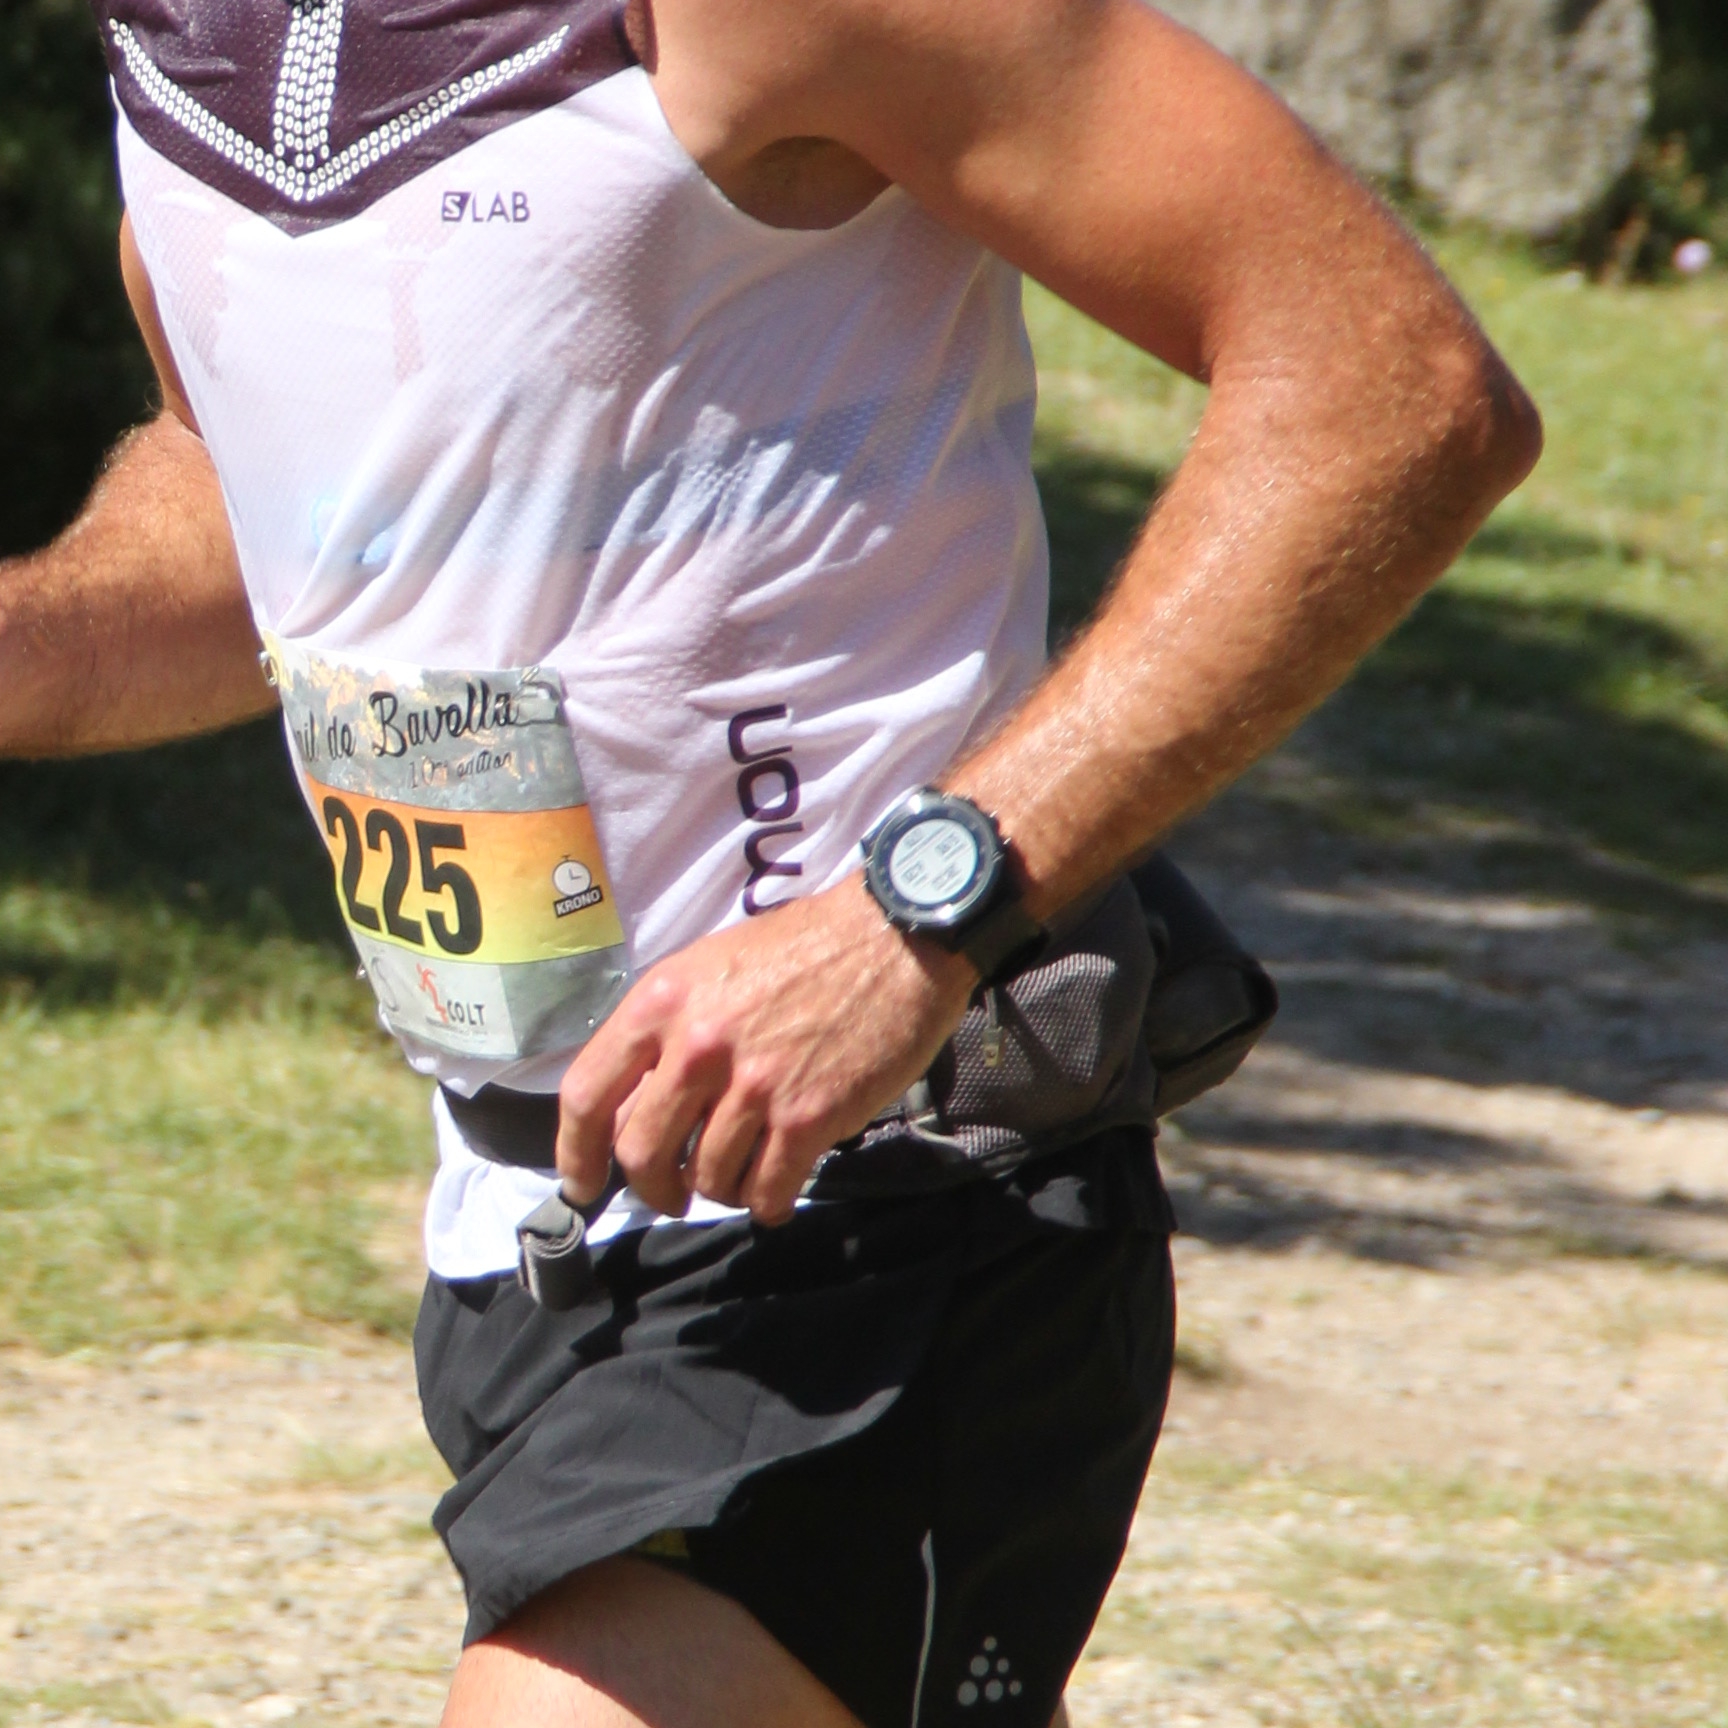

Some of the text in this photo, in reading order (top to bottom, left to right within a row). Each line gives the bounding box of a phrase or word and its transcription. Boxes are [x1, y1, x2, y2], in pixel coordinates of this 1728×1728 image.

[327, 715, 357, 760] de
[369, 679, 519, 758] Bavella
[322, 796, 483, 956] 225
[555, 888, 601, 916] KRONO
[446, 998, 485, 1026] COLT
